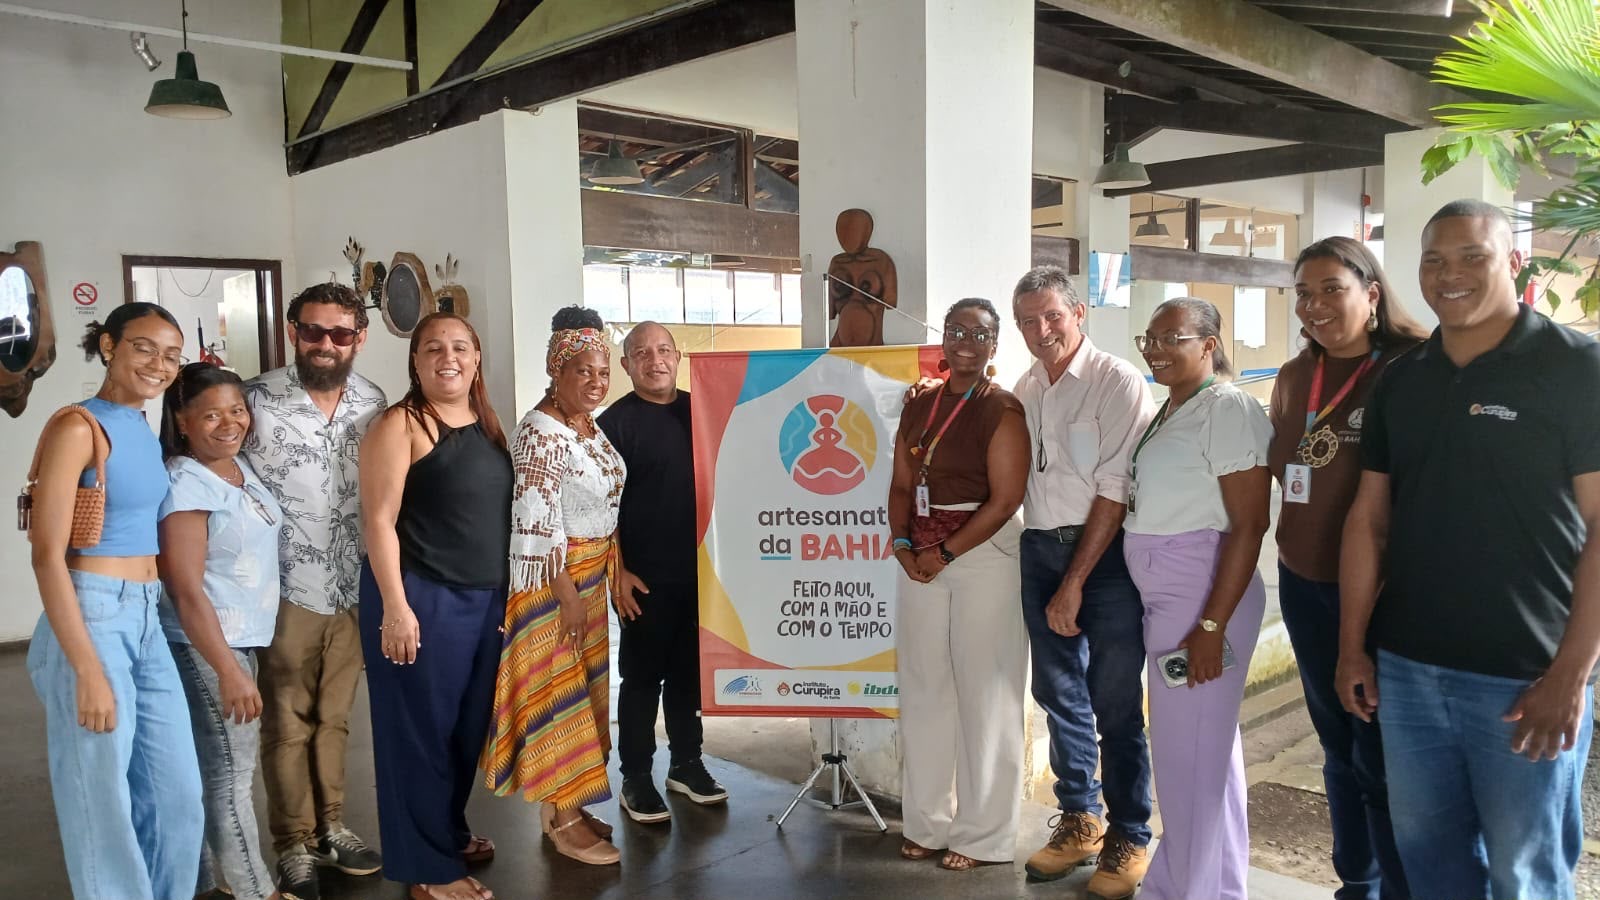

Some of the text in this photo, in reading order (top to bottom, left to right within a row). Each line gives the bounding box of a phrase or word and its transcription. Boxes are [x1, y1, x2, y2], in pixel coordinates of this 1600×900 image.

[758, 507, 887, 526] artesanat
[759, 534, 791, 554] da
[793, 580, 875, 599] FEITO AQUI,
[780, 600, 887, 618] COM A MÃO E
[777, 619, 892, 639] COM O TEMPO
[792, 682, 841, 698] Curupira
